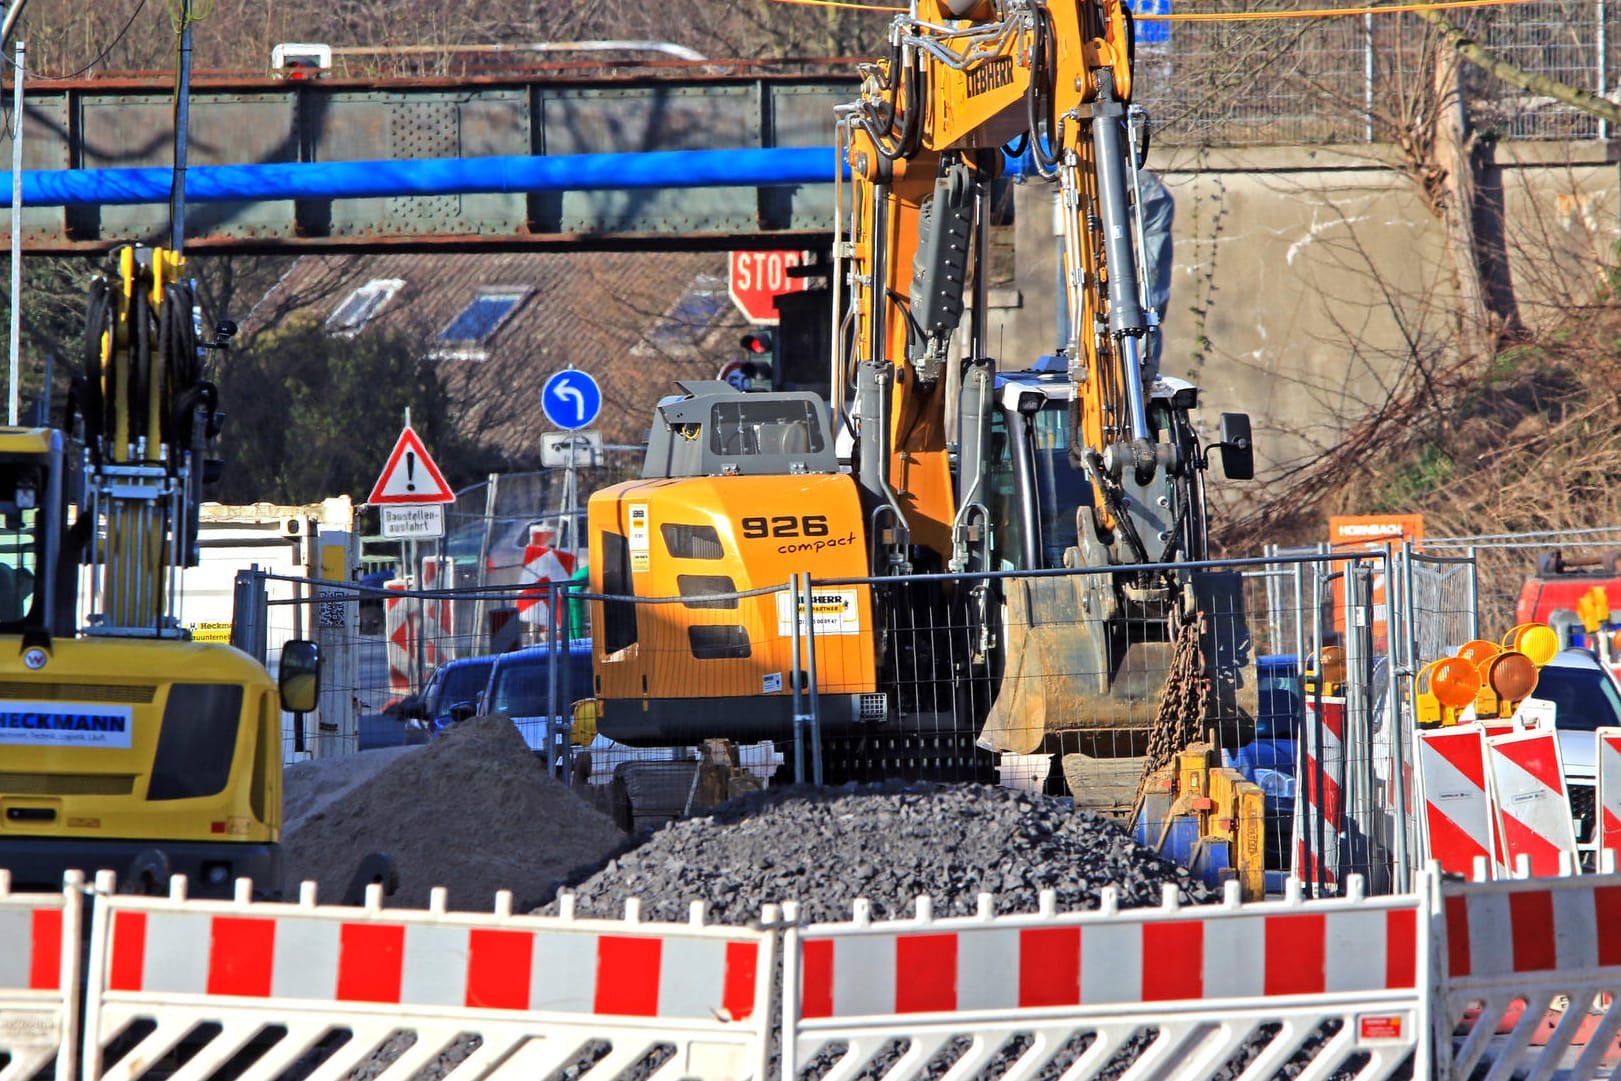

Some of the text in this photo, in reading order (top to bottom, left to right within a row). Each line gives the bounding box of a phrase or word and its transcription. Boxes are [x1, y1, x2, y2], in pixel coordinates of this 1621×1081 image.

[967, 57, 1014, 98] LIEBHERR
[738, 253, 798, 291] STOP
[742, 516, 828, 538] 926
[1339, 524, 1402, 536] HORNBACH
[778, 532, 856, 553] compact
